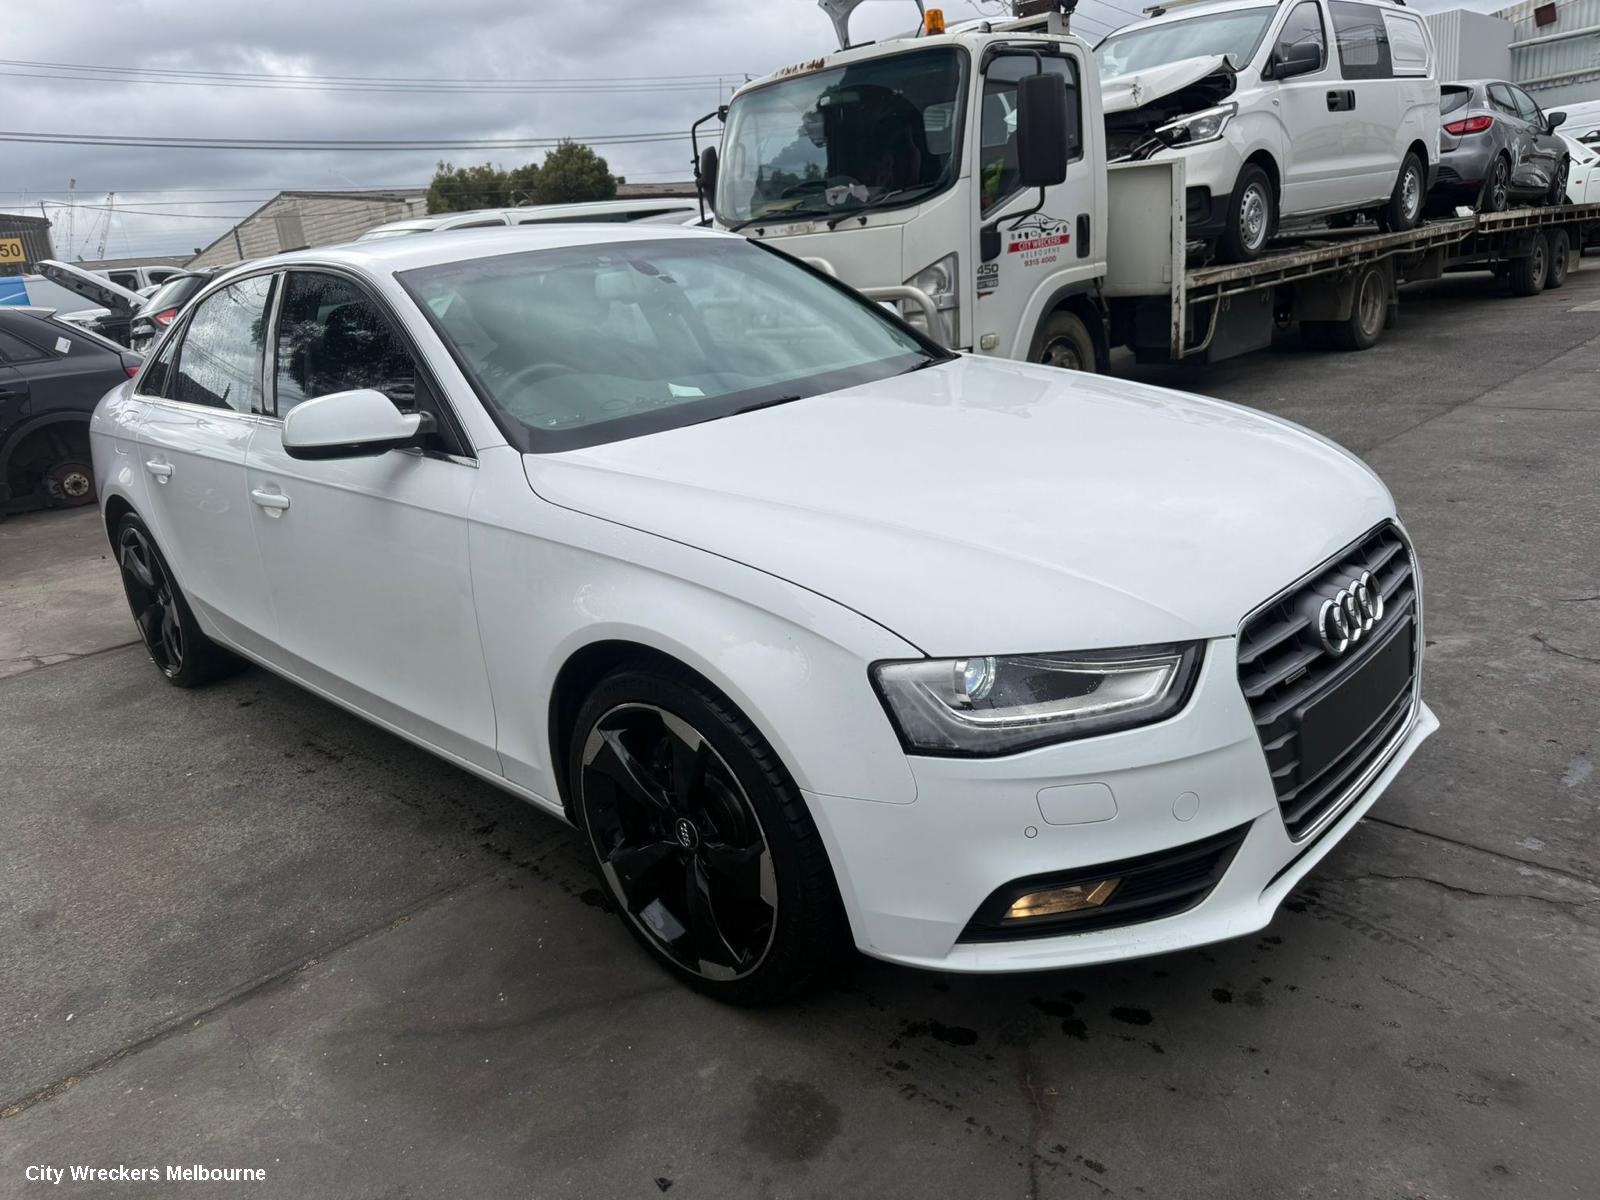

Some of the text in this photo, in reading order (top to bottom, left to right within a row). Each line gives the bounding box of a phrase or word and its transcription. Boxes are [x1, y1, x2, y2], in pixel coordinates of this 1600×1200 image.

[1018, 235, 1061, 251] CITY WRECKERS
[1020, 246, 1060, 259] MELBOURNE
[977, 263, 999, 275] 450
